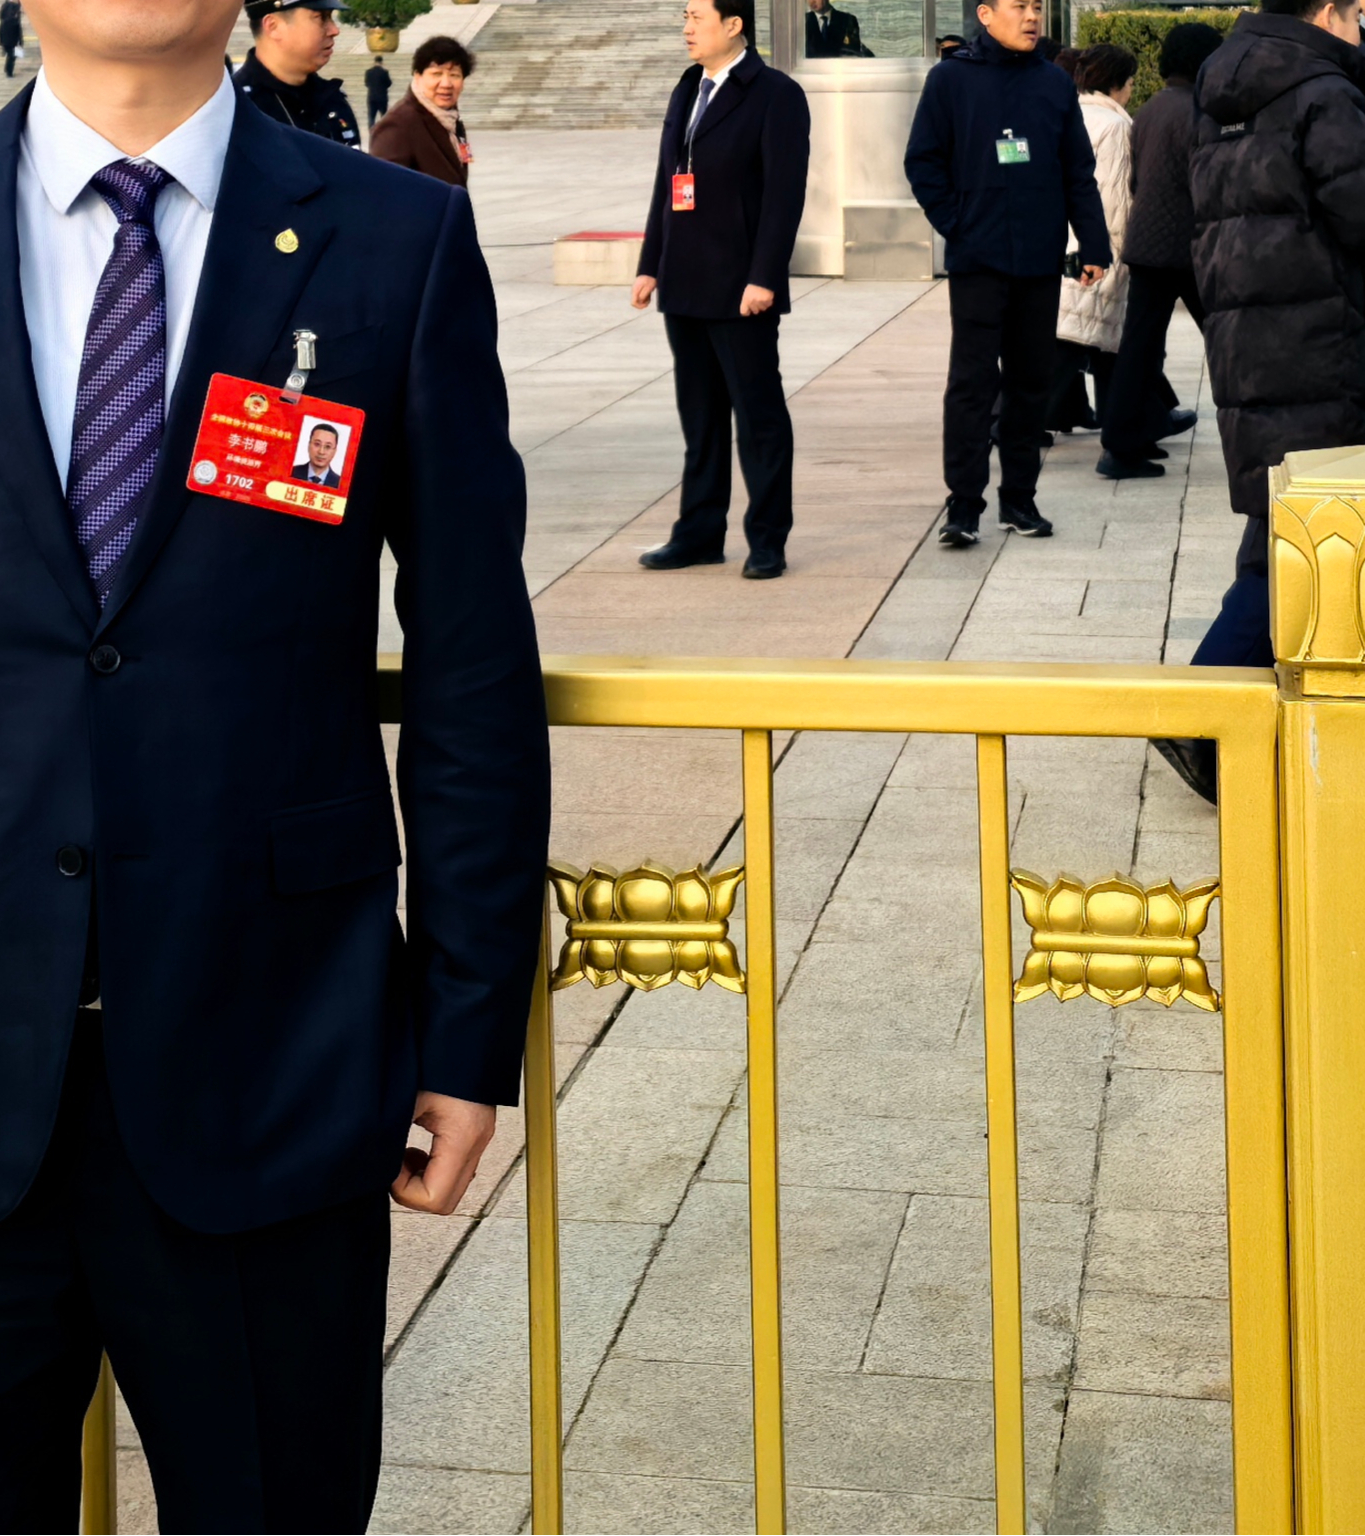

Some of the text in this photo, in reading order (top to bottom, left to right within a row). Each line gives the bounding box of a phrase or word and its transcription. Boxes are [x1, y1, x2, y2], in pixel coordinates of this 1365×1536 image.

[225, 473, 254, 490] 1702
[284, 486, 336, 511] 出席证
